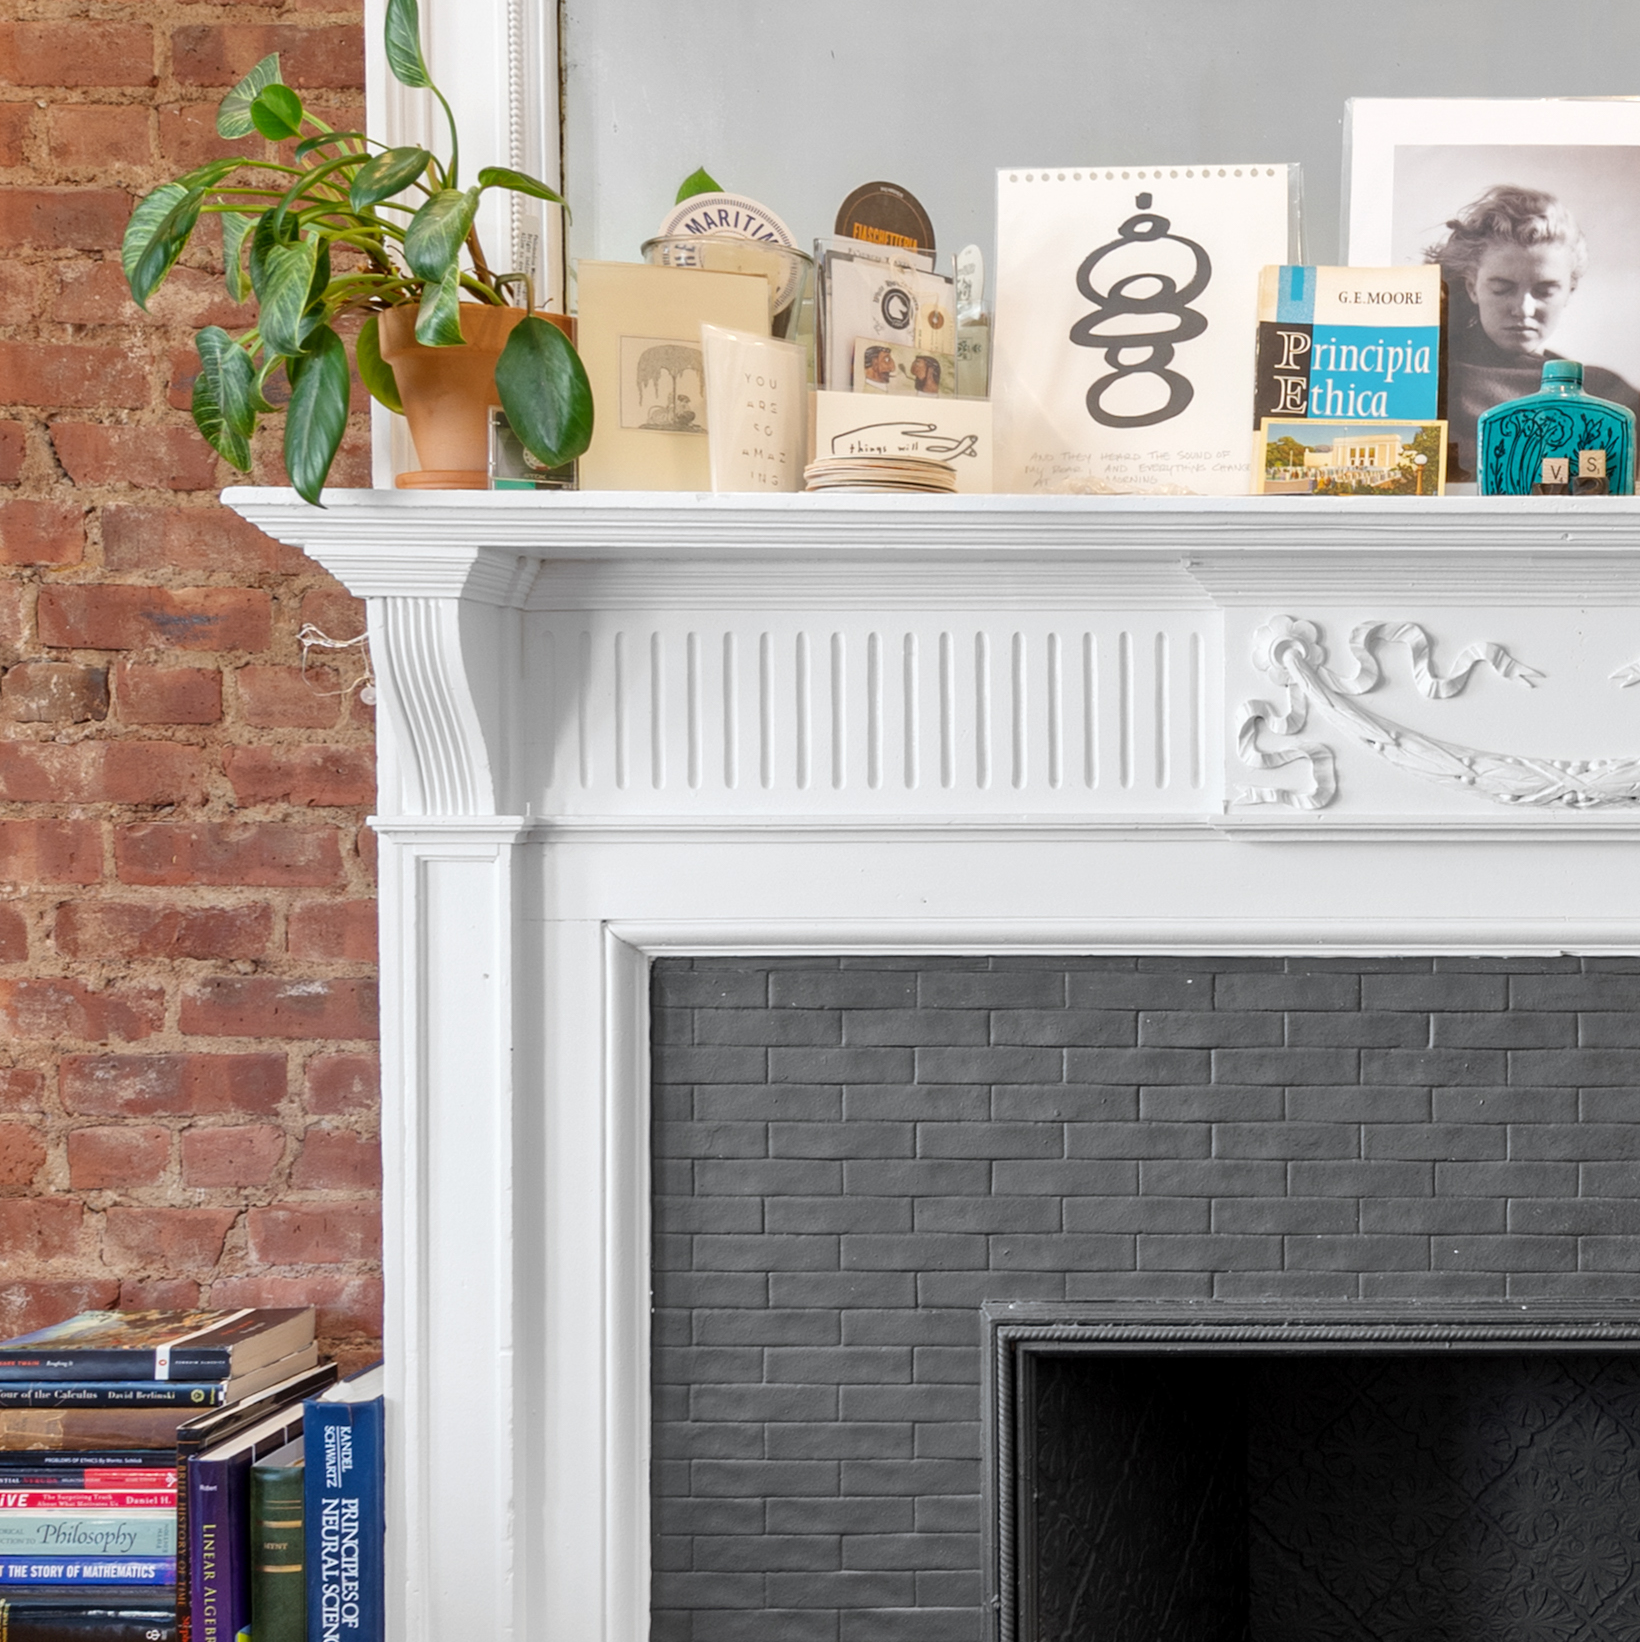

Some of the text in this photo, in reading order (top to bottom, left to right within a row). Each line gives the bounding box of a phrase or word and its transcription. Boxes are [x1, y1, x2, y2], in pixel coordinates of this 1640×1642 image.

[1274, 329, 1431, 385] Principia
[745, 373, 778, 391] YOU
[1271, 375, 1389, 419] Ethica
[848, 440, 919, 455] things will
[324, 1425, 337, 1488] SCHWARTZ
[340, 1426, 353, 1472] KANDEL
[37, 1522, 137, 1553] Philosophy
[203, 1524, 216, 1581] LINEAR
[322, 1498, 339, 1580] NEURAL
[9, 1565, 155, 1578] THE STORY OF MATHEMATICS
[341, 1498, 359, 1628] PRINCIPLES OF
